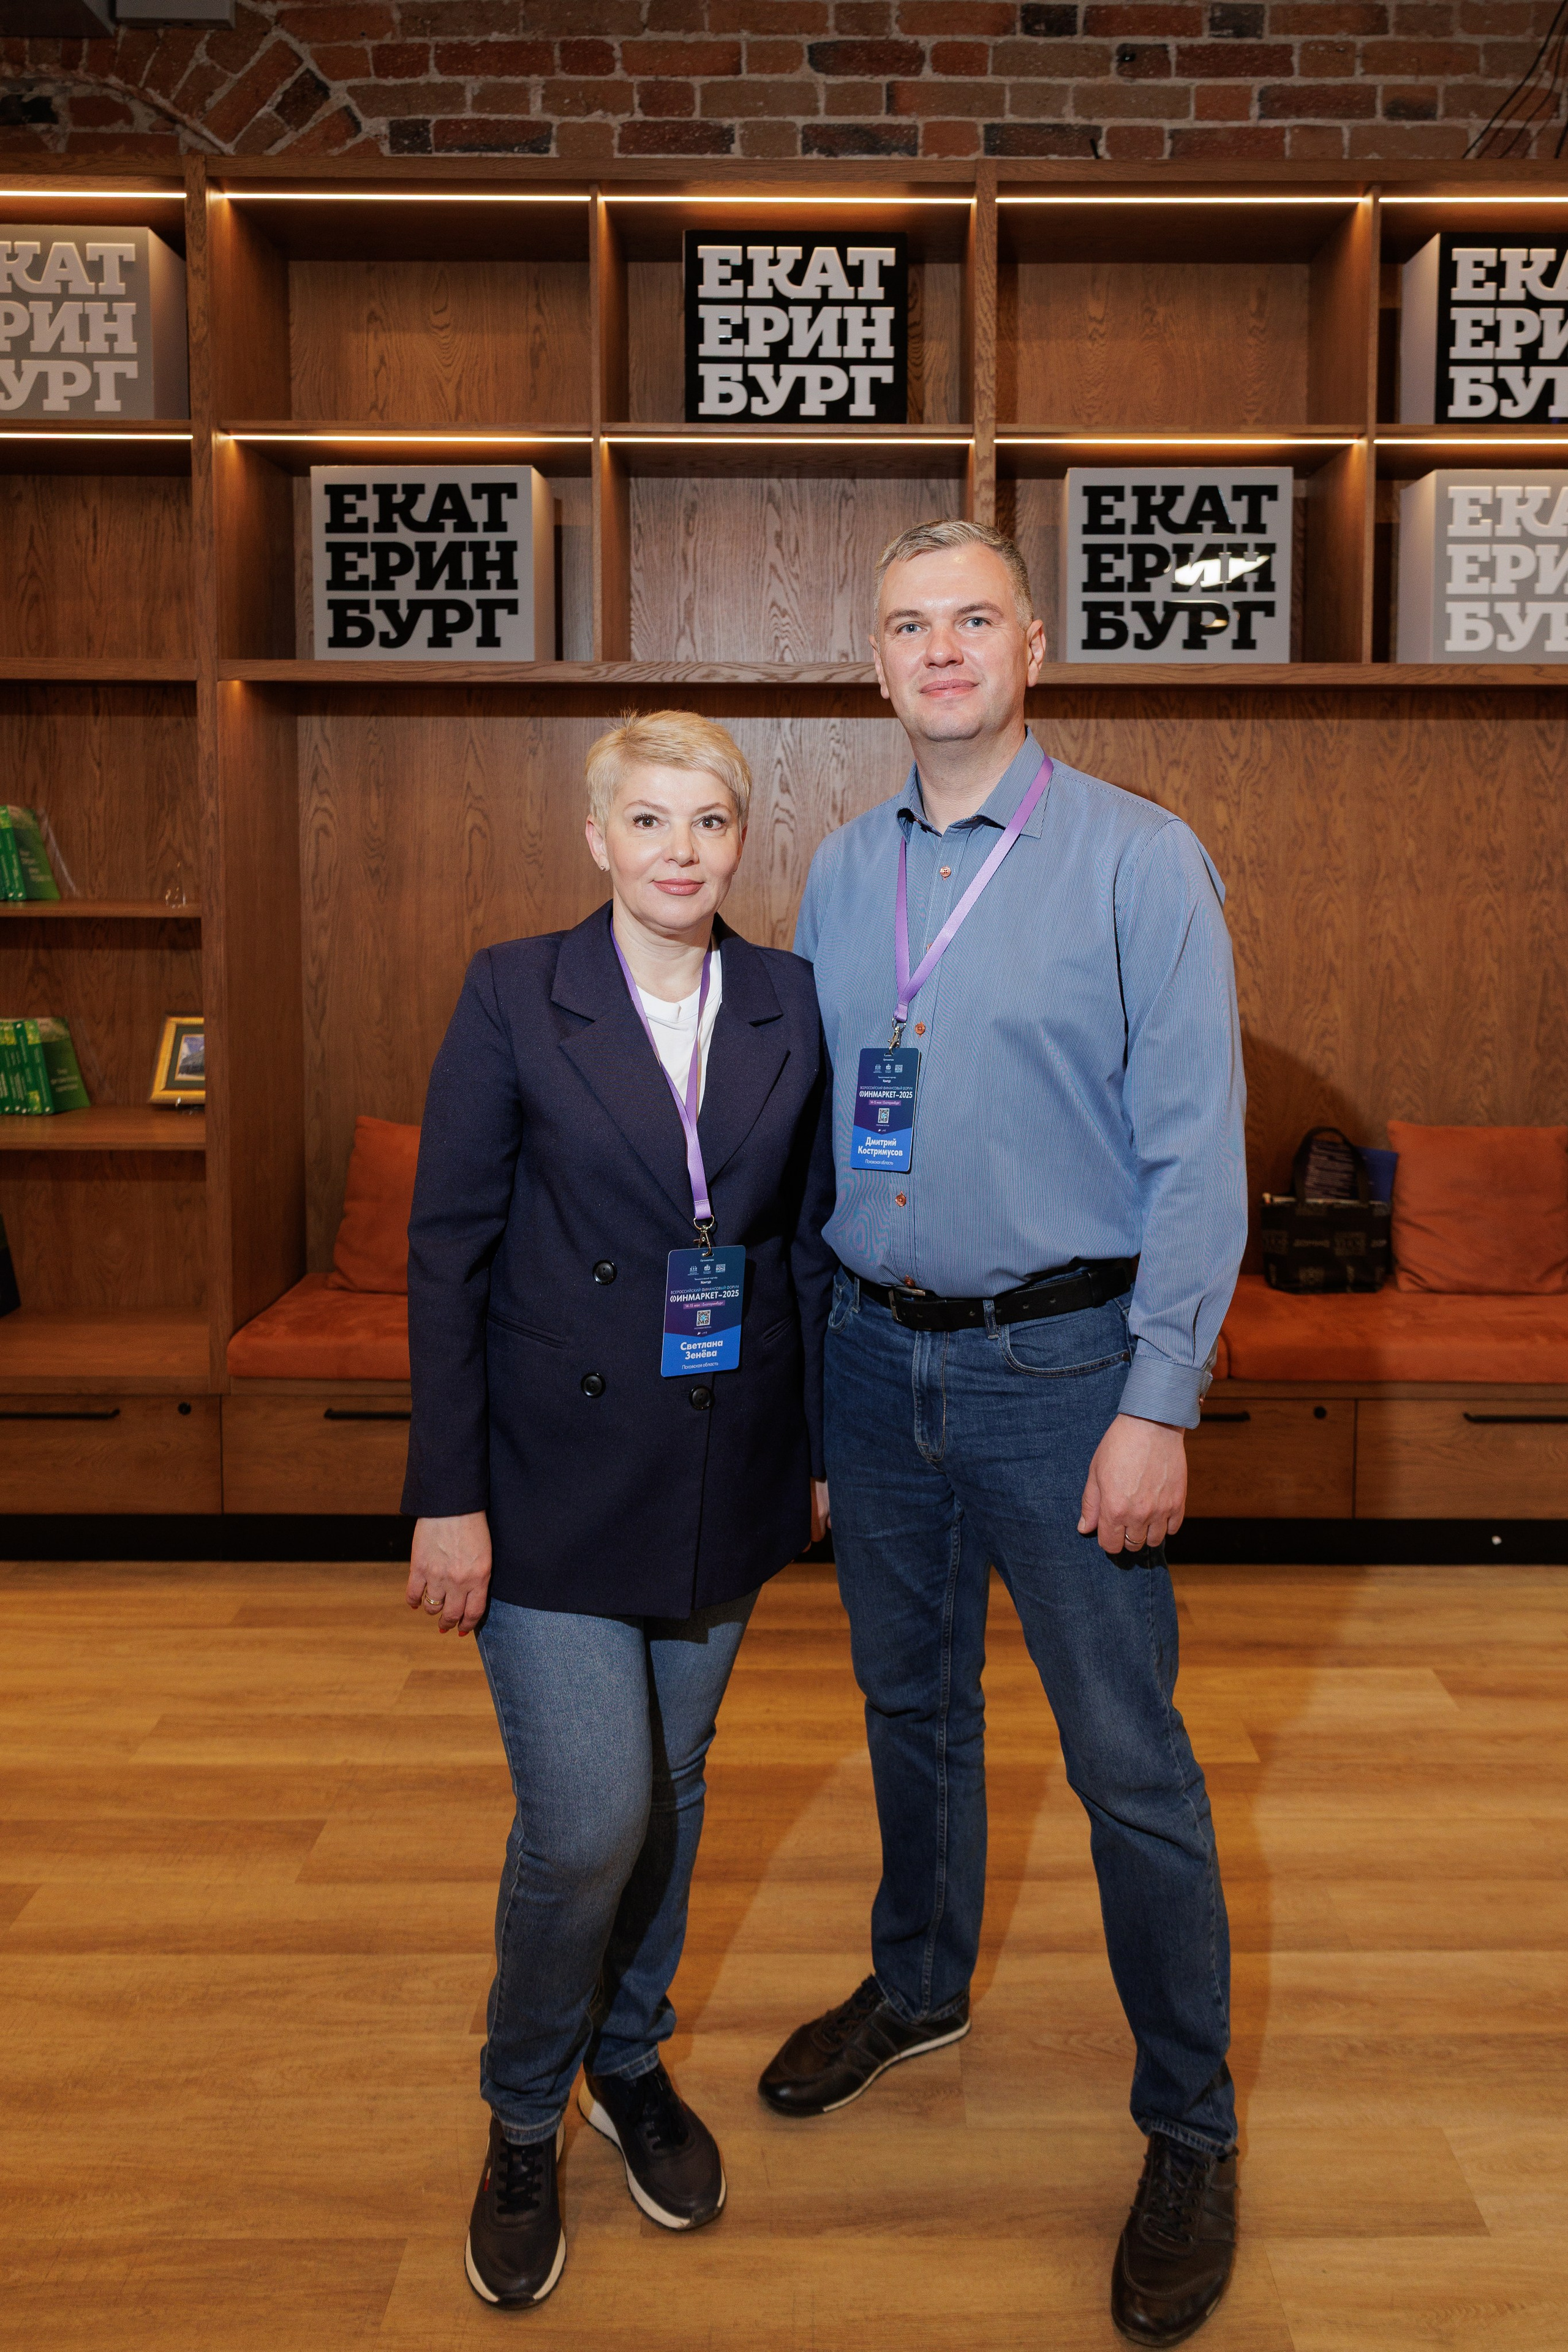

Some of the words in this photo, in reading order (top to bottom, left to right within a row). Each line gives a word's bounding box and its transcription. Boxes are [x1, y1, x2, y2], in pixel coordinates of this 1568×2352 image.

[698, 245, 896, 300] ЕКАТ
[1450, 247, 1568, 301] ЕК
[698, 304, 895, 358] ЕРИН
[698, 363, 894, 417] БУРГ
[323, 482, 518, 533] ЕКАТ
[1082, 484, 1278, 535] ЕКАТ
[325, 540, 518, 591] ЕРИН
[1082, 543, 1276, 592] ЕРИН
[327, 598, 519, 649] БУРГ
[1081, 600, 1276, 650] БУРГ
[858, 1145, 903, 1158] Костримусов
[865, 1136, 897, 1148] Дмитрий
[680, 1340, 723, 1351] Светлана
[684, 1349, 717, 1360] Зенёва
